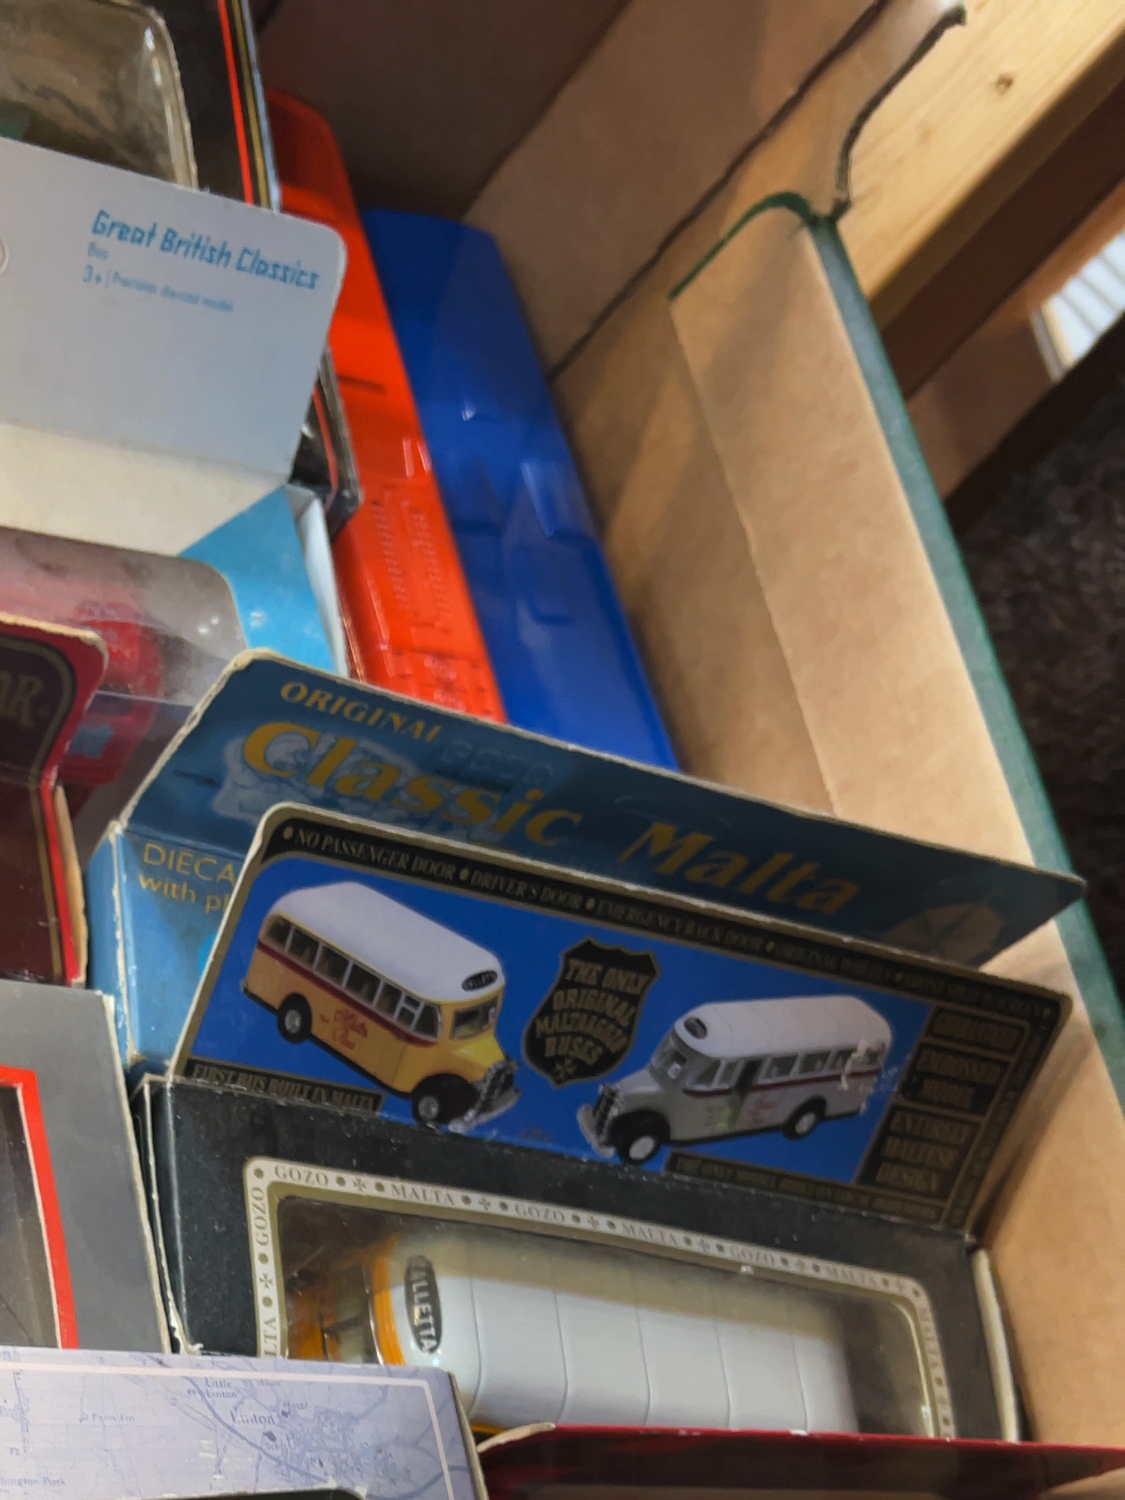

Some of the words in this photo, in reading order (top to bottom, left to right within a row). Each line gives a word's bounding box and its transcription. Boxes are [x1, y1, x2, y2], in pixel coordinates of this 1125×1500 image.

[91, 209, 157, 248] Great
[159, 227, 231, 268] British
[235, 246, 320, 289] Classics
[279, 680, 442, 743] ORIGINAL
[242, 721, 584, 847] Classic
[617, 822, 862, 917] Malta
[294, 828, 320, 848] NO
[322, 832, 410, 870] PASSENGER
[411, 853, 456, 881] DOOR
[138, 872, 196, 904] with
[566, 958, 603, 986] THE
[602, 967, 651, 995] ONLY
[553, 988, 636, 1027] ORIGINAL
[544, 1035, 604, 1067] BUSES
[251, 1186, 271, 1247] GOZO
[275, 1165, 330, 1187] GOZO
[391, 1183, 456, 1207] MALTA
[515, 1203, 567, 1224] GOZO
[621, 1223, 678, 1247] MALTA
[730, 1246, 777, 1266] GOZO
